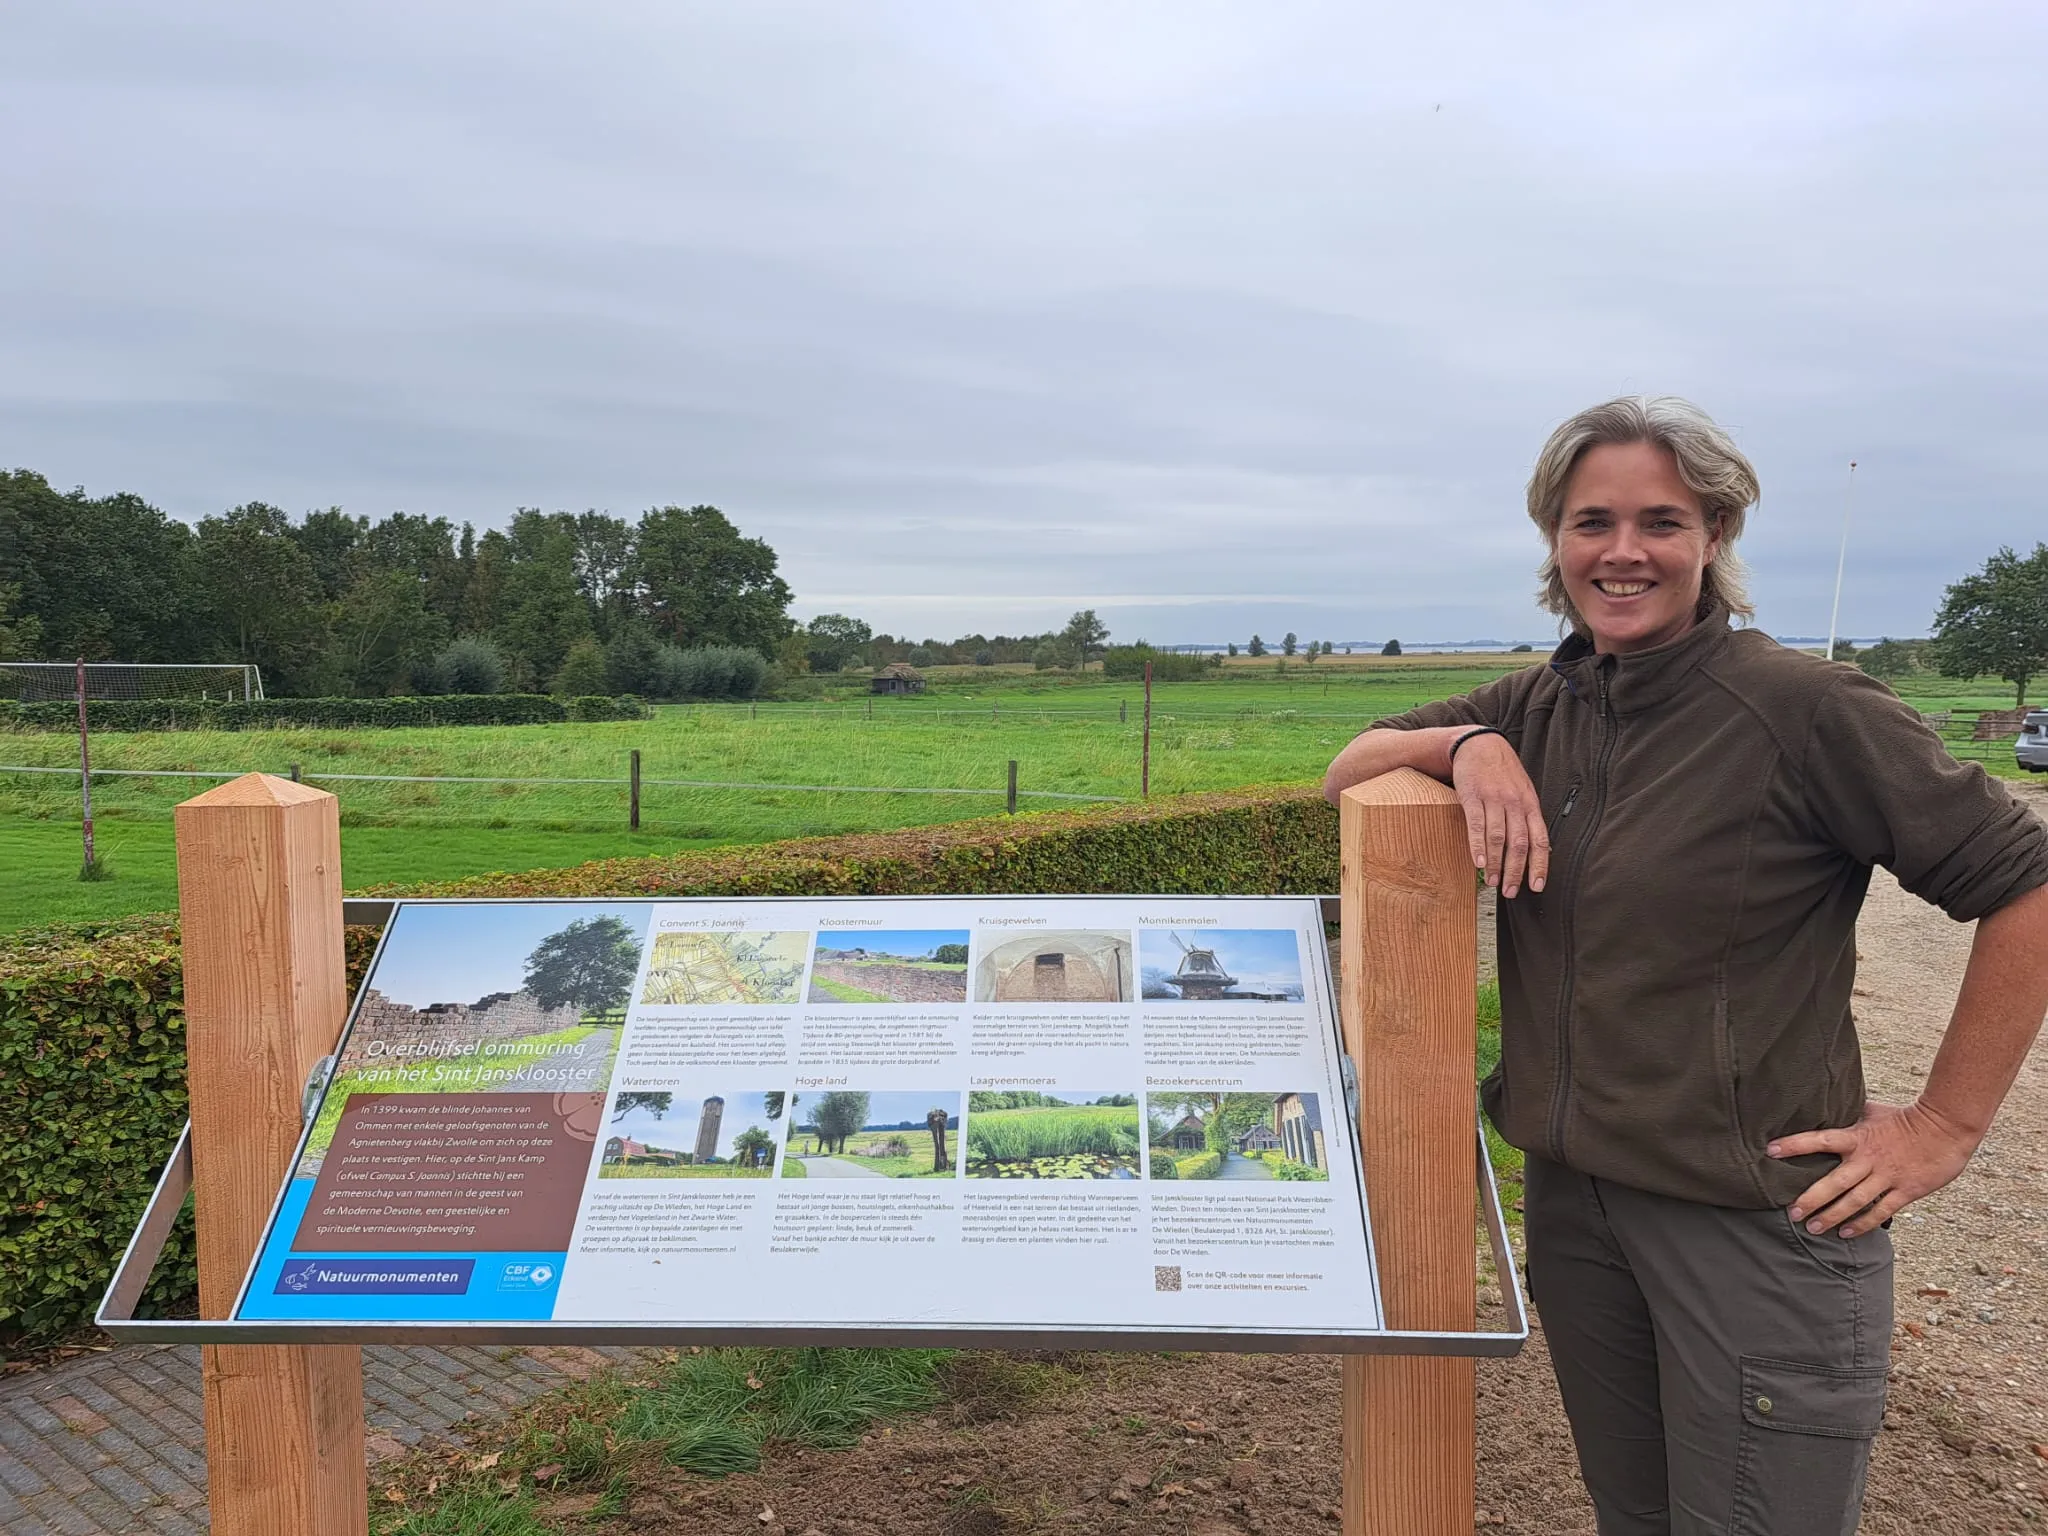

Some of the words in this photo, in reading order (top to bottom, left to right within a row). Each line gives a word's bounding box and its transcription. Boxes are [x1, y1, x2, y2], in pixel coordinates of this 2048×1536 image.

[659, 919, 700, 928] Convent
[700, 919, 710, 928] S.
[712, 919, 746, 929] Joannis
[819, 918, 884, 926] Kloostermuur
[978, 917, 1047, 927] Kruisgewelven
[1138, 916, 1218, 925] Monnikenmolen
[368, 1039, 479, 1060] Overblijfsel
[484, 1039, 586, 1060] ommuring
[357, 1069, 390, 1080] van
[394, 1064, 427, 1080] het
[428, 1064, 470, 1080] Sint
[472, 1064, 596, 1085] Jansklooster
[622, 1077, 680, 1086] Watertoren
[796, 1076, 824, 1087] Hoge
[825, 1076, 848, 1085] land
[970, 1076, 1056, 1087] Laagveenmoeras
[1146, 1076, 1242, 1086] Bezoekerscentrum
[361, 1104, 370, 1114] In
[372, 1104, 397, 1114] 1399
[398, 1104, 426, 1114] kwam
[428, 1104, 440, 1114] de
[441, 1104, 470, 1113] blinde
[471, 1104, 512, 1116] Johannes
[355, 1120, 392, 1130] Ommen
[393, 1120, 412, 1130] met
[413, 1120, 444, 1130] enkele
[445, 1120, 516, 1132] geloofsgenoten
[536, 1120, 548, 1129] de
[349, 1137, 411, 1149] Agnietenberg
[413, 1136, 444, 1149] vlakbij
[445, 1136, 477, 1146] Zwolle
[496, 1136, 514, 1146] zich
[516, 1139, 528, 1149] op
[530, 1136, 552, 1146] deze
[342, 1153, 369, 1166] plaats
[371, 1153, 380, 1163] te
[382, 1153, 423, 1166] vestigen.
[425, 1153, 448, 1166] Hier,
[449, 1156, 462, 1166] op
[463, 1153, 475, 1163] de
[477, 1153, 495, 1163] Sint
[496, 1153, 516, 1166] Jans
[517, 1153, 544, 1166] Kamp
[336, 1170, 368, 1183] (ofwel
[369, 1170, 406, 1183] Campus
[407, 1170, 416, 1180] S.
[416, 1170, 455, 1183] Joannis)
[456, 1170, 491, 1180] stichtte
[492, 1170, 504, 1183] hij
[330, 1188, 394, 1200] gemeenschap
[454, 1188, 463, 1197] in
[465, 1188, 477, 1197] de
[478, 1188, 504, 1200] geest
[323, 1206, 335, 1215] de
[336, 1206, 381, 1215] Moderne
[383, 1205, 423, 1218] Devotie,
[445, 1205, 495, 1218] geestelijke
[316, 1223, 360, 1236] spirituele
[362, 1223, 476, 1236] vernieuwingsbeweging.
[317, 1269, 459, 1283] Natuurmonumenten
[506, 1266, 530, 1274] CBF
